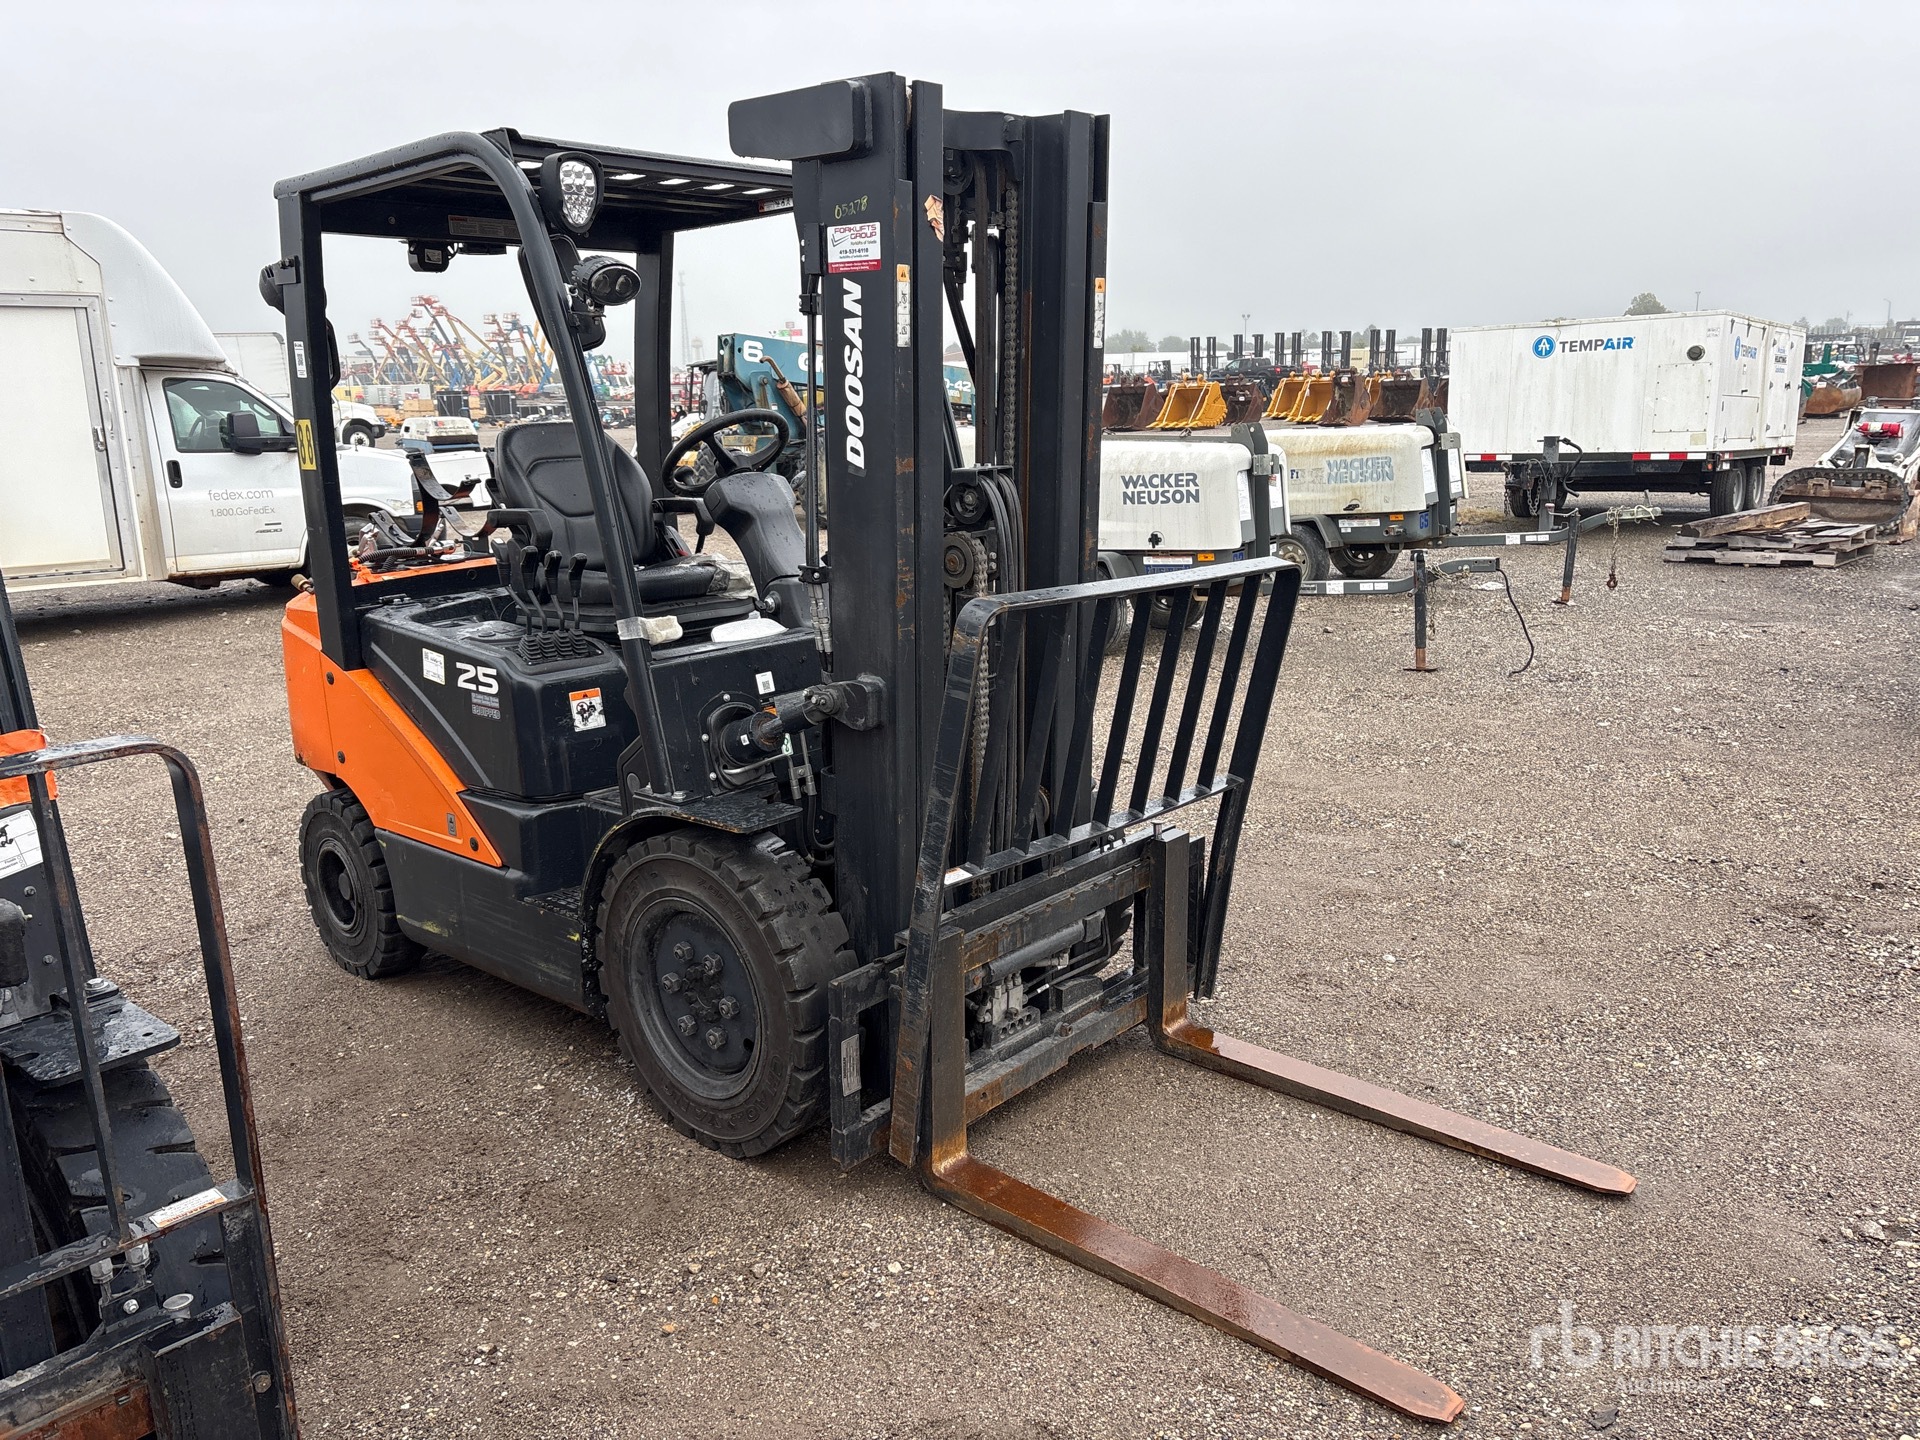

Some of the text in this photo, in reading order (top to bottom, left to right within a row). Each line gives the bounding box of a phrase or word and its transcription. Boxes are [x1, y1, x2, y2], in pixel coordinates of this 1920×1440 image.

[835, 195, 868, 219] 05278
[834, 223, 876, 234] FORKLIFTS
[850, 231, 876, 240] GROUP
[743, 340, 764, 363] 6
[843, 277, 865, 470] DOOSAN
[1326, 456, 1393, 472] WACKER
[1120, 472, 1200, 490] WACKER
[1327, 467, 1395, 485] NEUSON
[208, 489, 274, 501] fedex.com
[1122, 489, 1200, 506] NEUSON
[210, 505, 276, 517] 1.800.GoFedEx
[456, 662, 499, 695] 25
